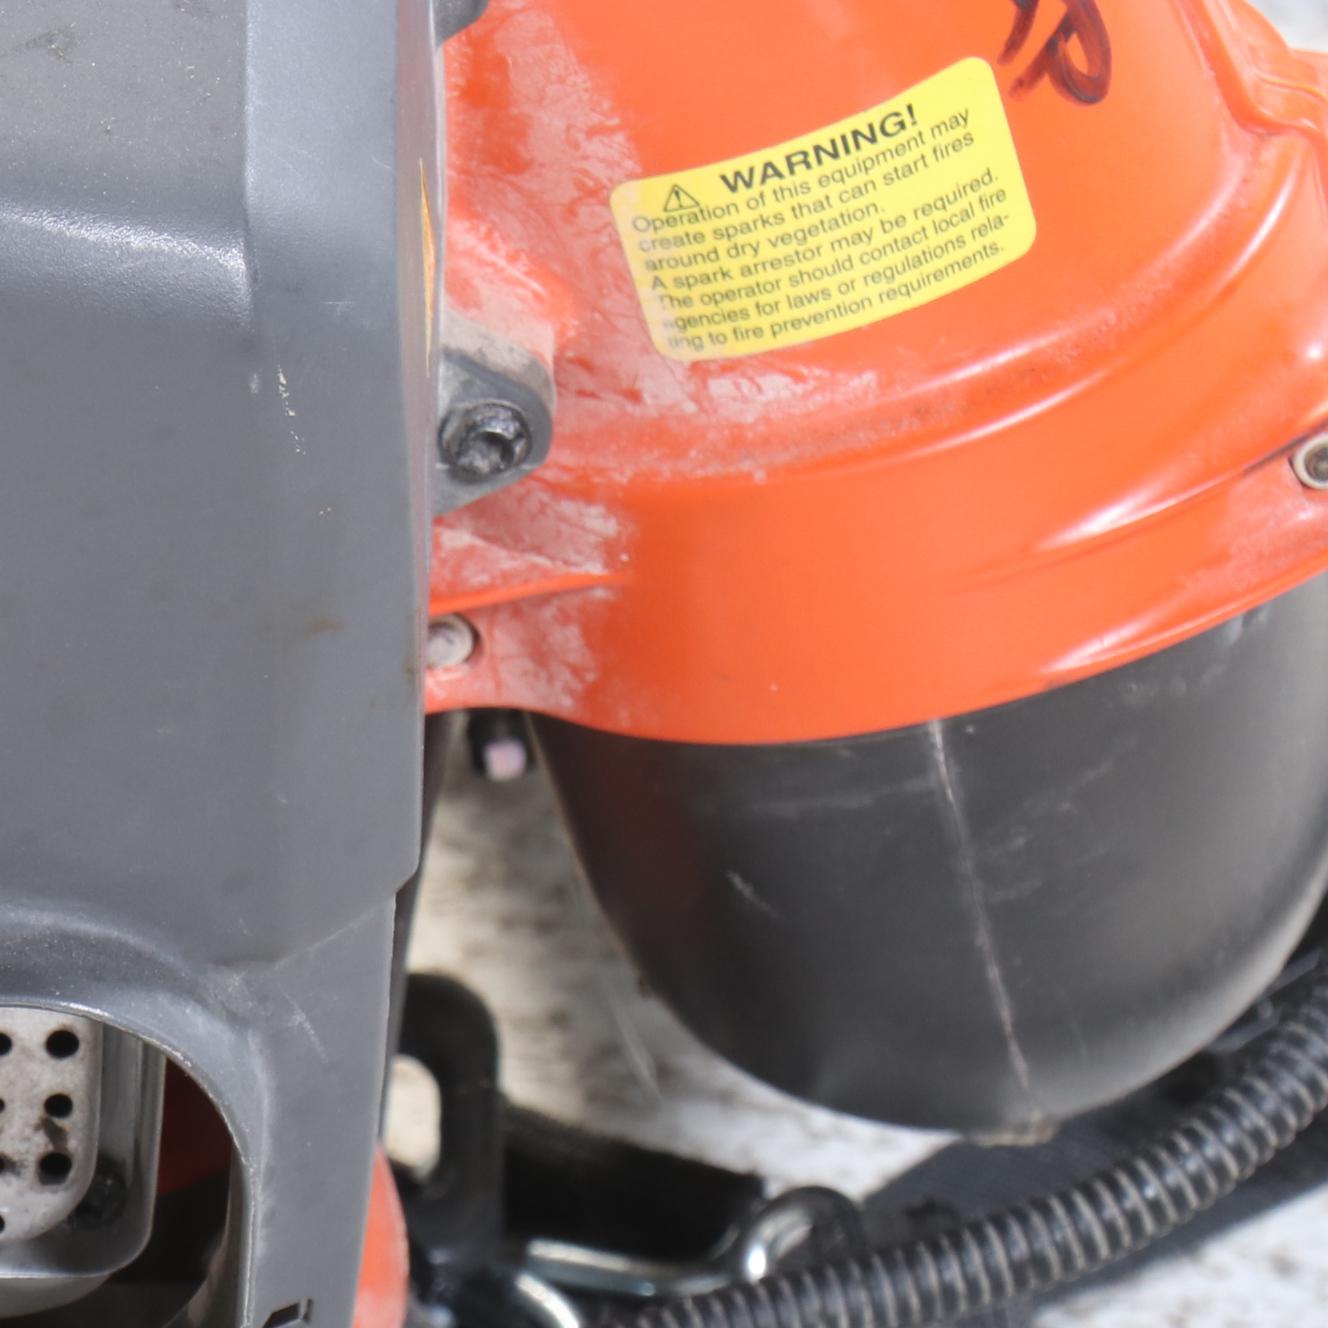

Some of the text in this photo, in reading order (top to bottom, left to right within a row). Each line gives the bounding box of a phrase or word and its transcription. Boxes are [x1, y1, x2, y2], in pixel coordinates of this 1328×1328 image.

[632, 108, 970, 233] Operation of this equipment may
[639, 131, 975, 252] create sparks that can start fires
[719, 103, 918, 193] WARNING!
[645, 200, 885, 271] around dry vegetation.
[652, 167, 998, 291] A spark arrestor may be required.
[658, 188, 1007, 311] The operator should contact local fire
[755, 299, 781, 317] for
[786, 287, 833, 309] laws
[838, 279, 857, 295] or
[863, 235, 967, 286] regulations
[971, 213, 1009, 240] rela-
[708, 330, 727, 345] to
[733, 325, 764, 340] fire
[770, 296, 872, 338] prevention
[878, 241, 1004, 304] requirements.
